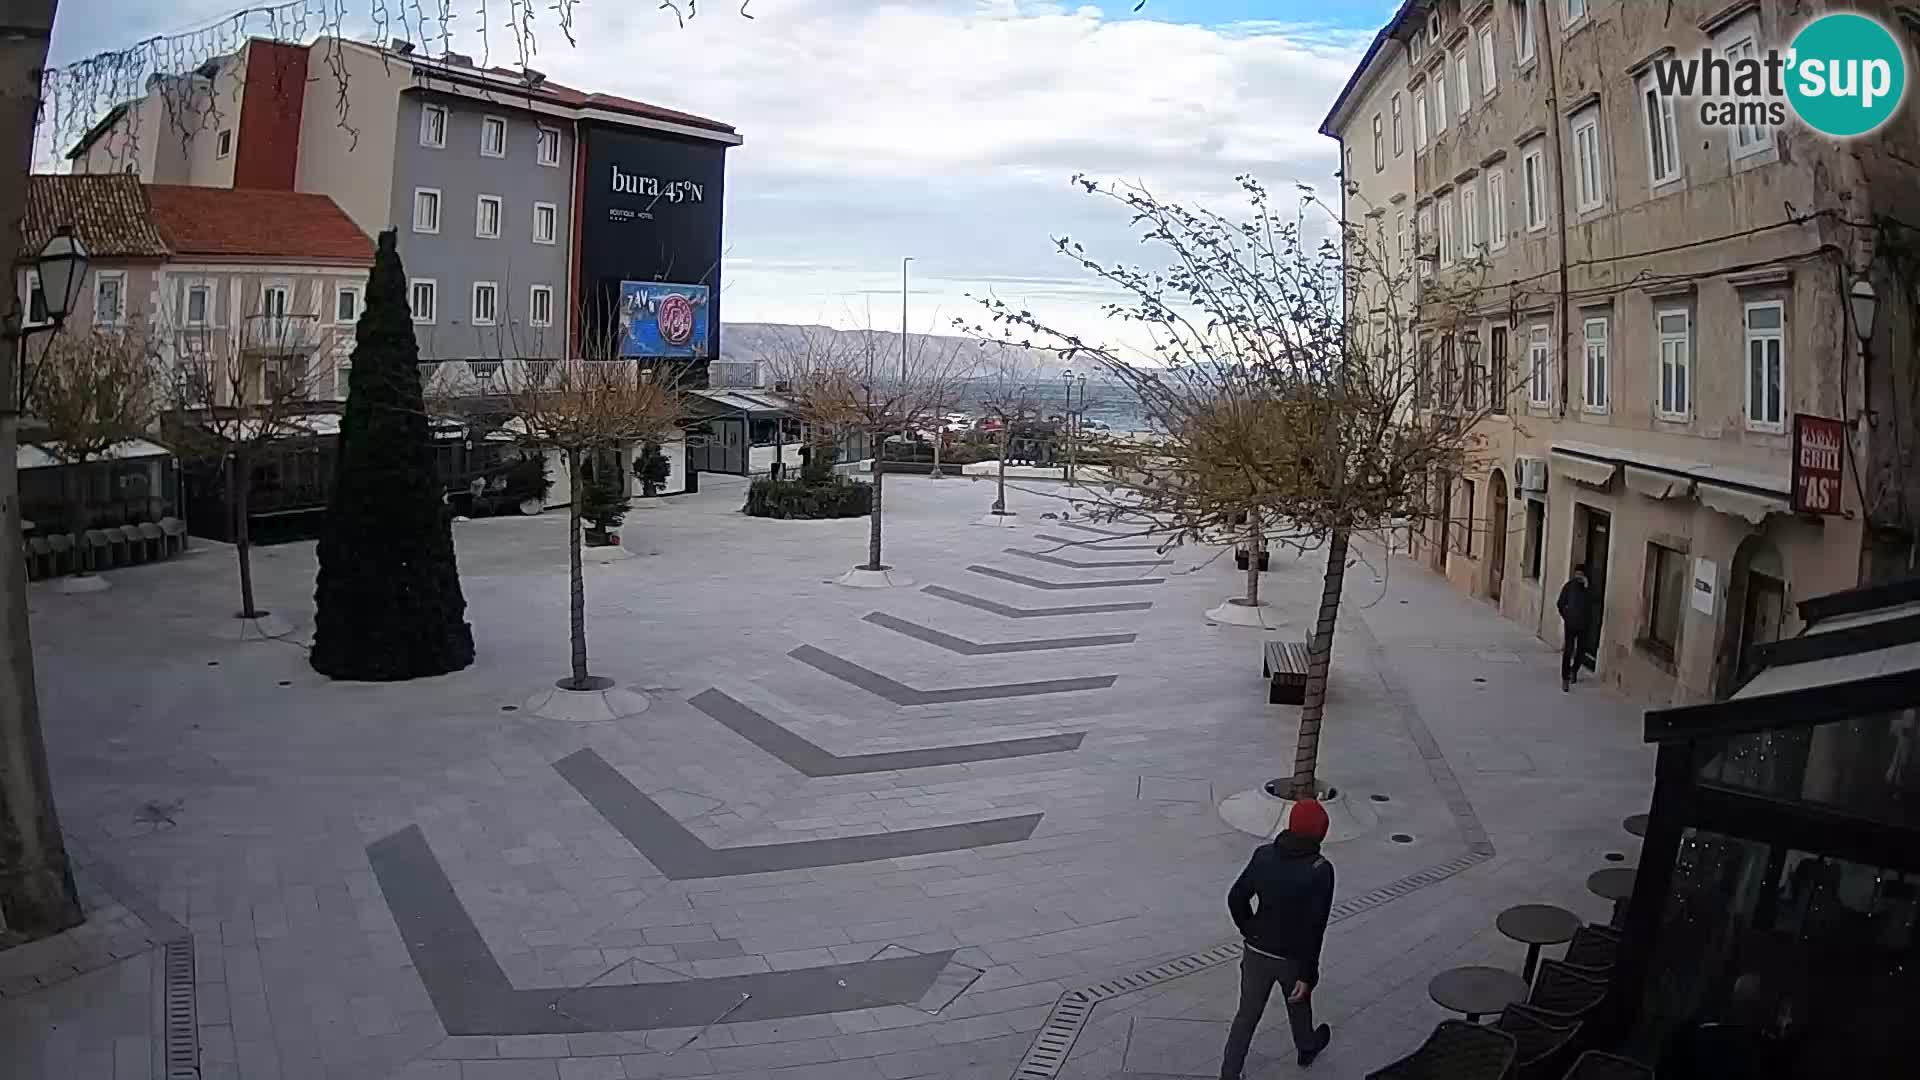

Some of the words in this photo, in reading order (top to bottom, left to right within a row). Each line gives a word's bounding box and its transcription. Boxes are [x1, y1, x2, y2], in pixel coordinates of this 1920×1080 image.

[612, 165, 658, 196] bura
[637, 212, 654, 220] HOTEL
[1800, 447, 1840, 471] GRILL
